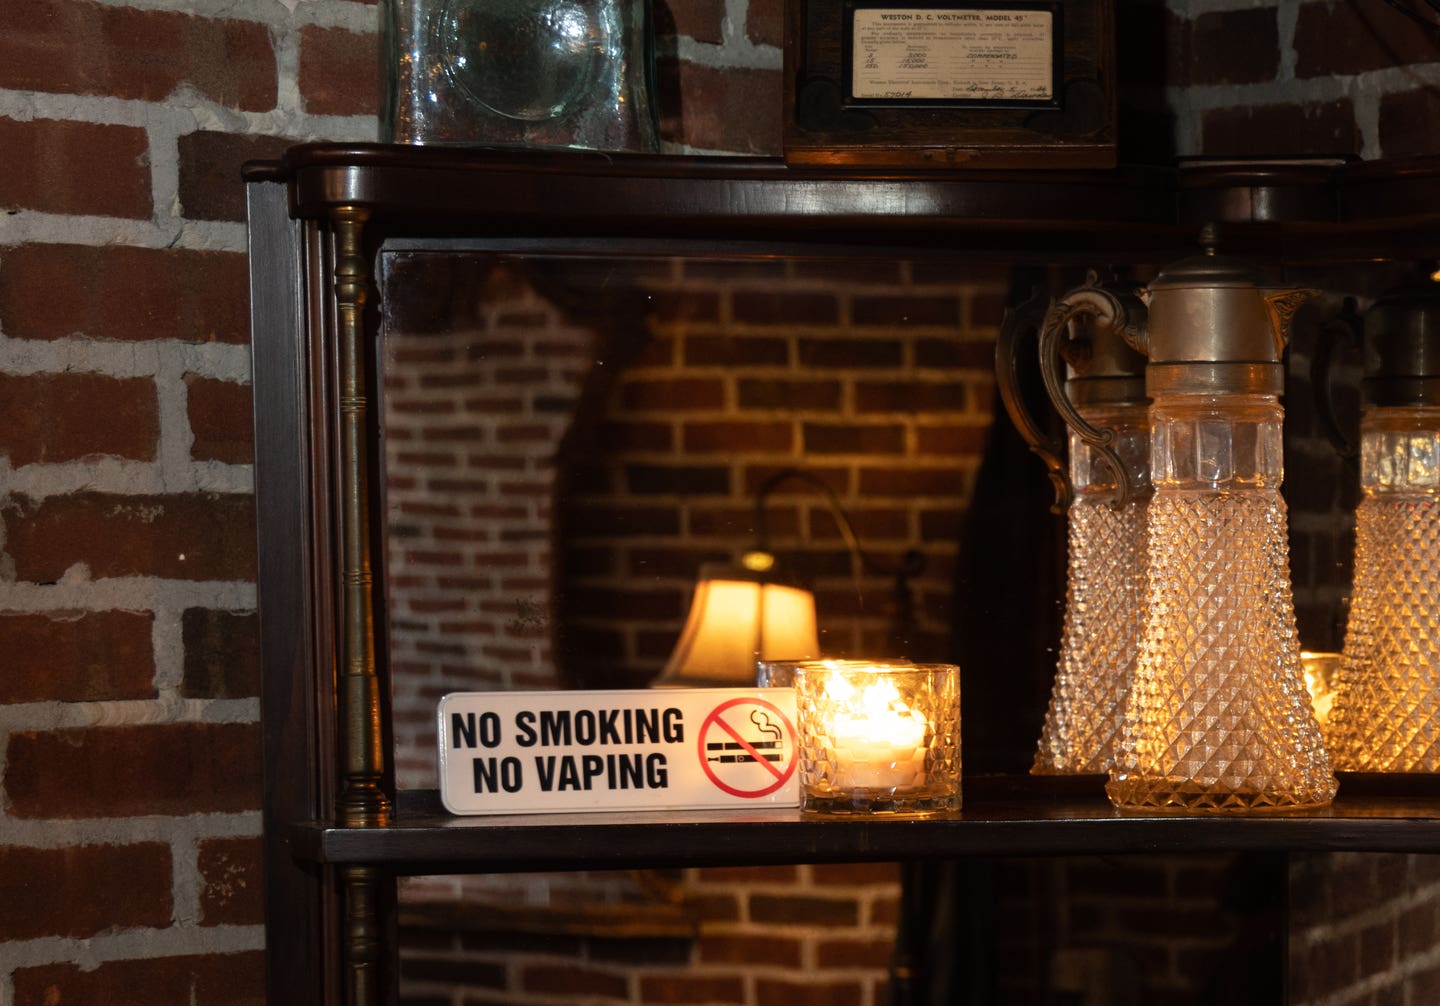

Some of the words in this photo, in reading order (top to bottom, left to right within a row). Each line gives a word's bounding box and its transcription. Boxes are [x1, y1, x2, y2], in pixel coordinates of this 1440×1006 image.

[451, 711, 502, 748] NO
[515, 707, 685, 748] SMOKING
[473, 756, 523, 794] NO
[535, 752, 669, 792] VAPING
